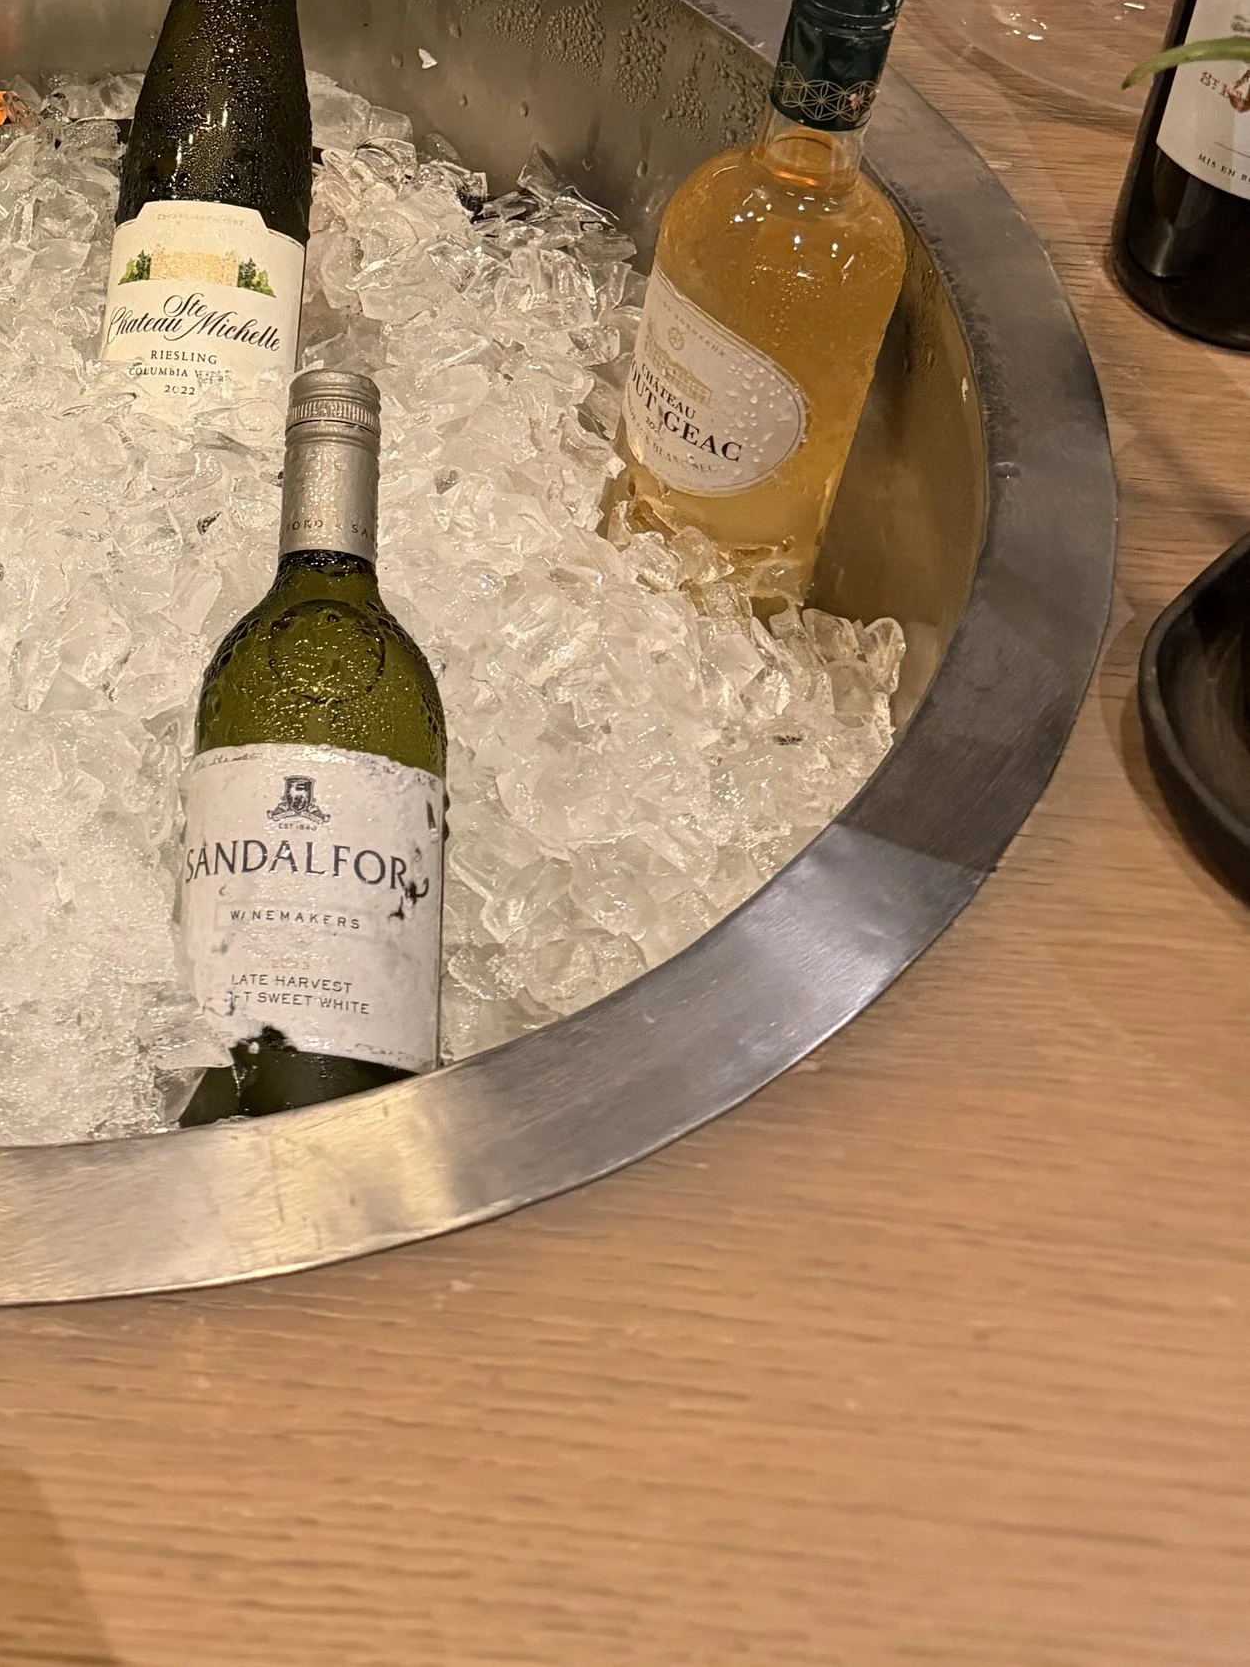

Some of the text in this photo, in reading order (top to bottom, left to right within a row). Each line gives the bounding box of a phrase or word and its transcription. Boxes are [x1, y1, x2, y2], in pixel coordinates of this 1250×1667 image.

[1198, 153, 1236, 177] MIS EN
[163, 292, 208, 318] Ste
[107, 305, 281, 353] Chateau Michelle
[150, 349, 218, 365] RIESLING
[128, 366, 189, 378] COLUMBIA
[164, 384, 196, 396] 2022
[642, 362, 696, 420] CHÂTEAU
[230, 910, 361, 931] WINEMAKERS
[231, 974, 353, 994] LATE HARVEST
[256, 991, 371, 1015] SWEET WHITE
